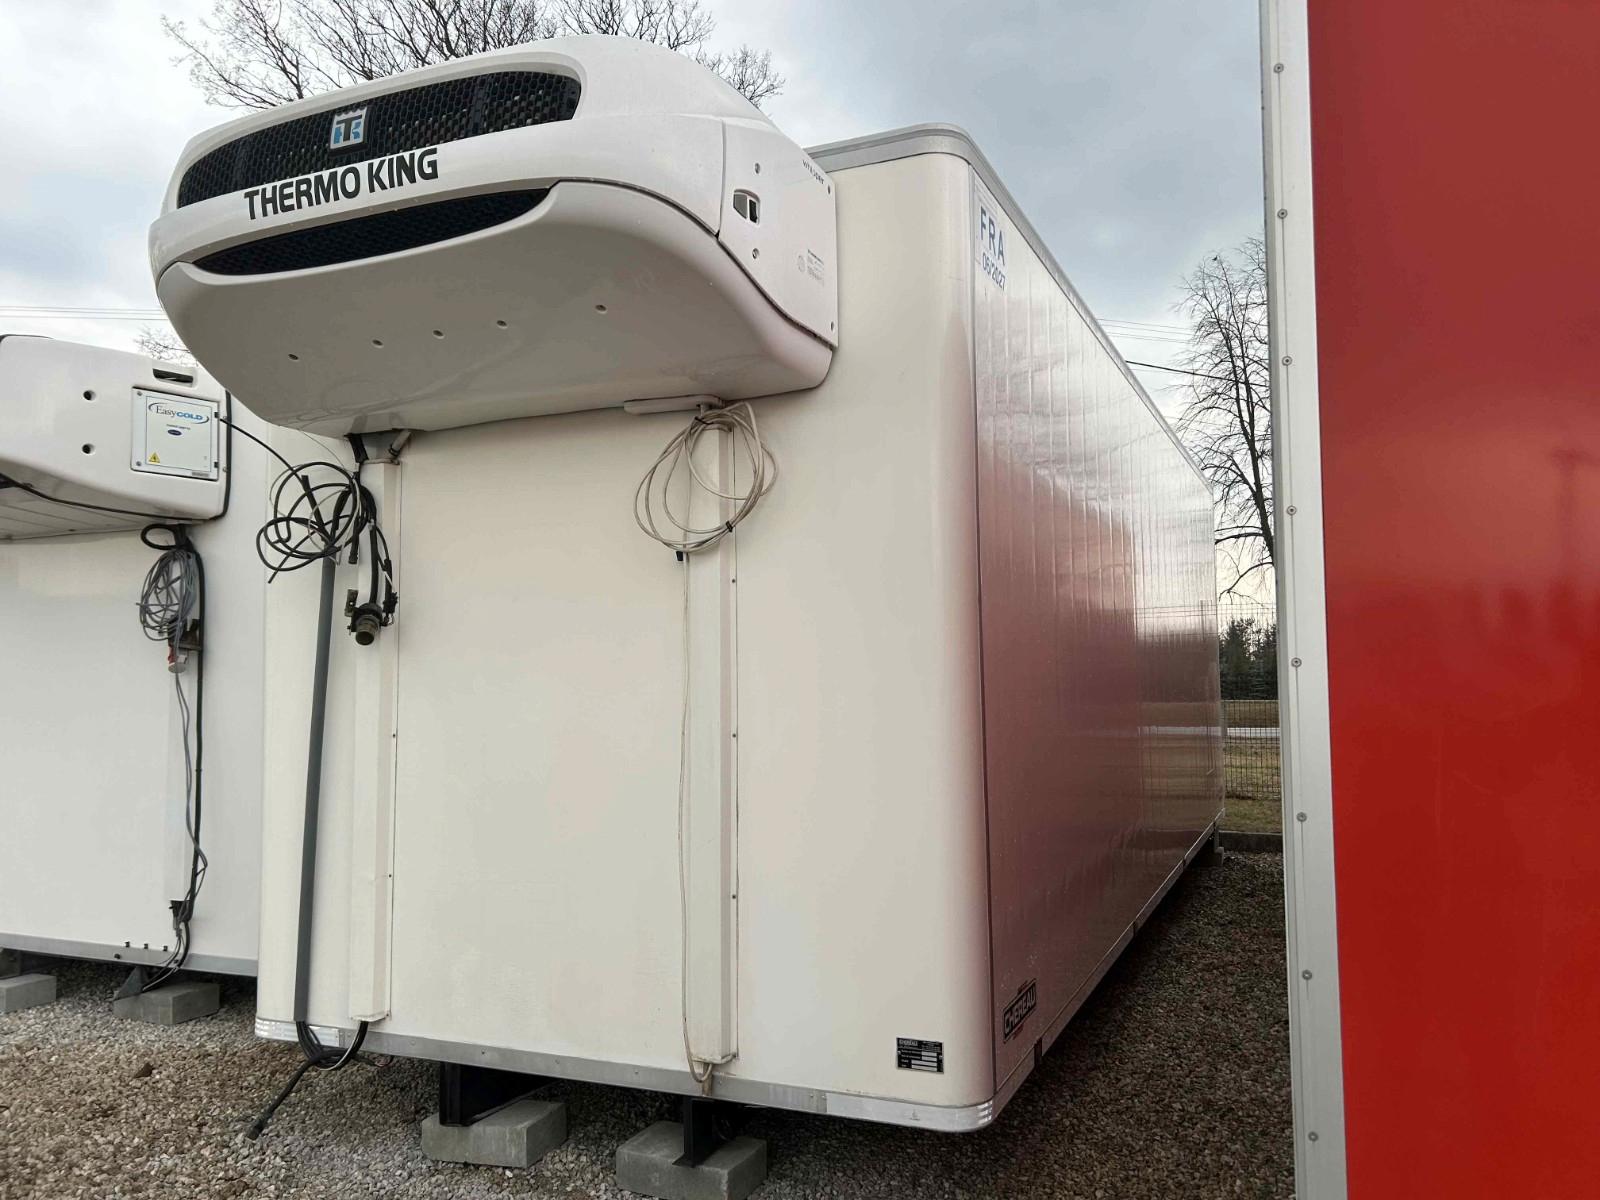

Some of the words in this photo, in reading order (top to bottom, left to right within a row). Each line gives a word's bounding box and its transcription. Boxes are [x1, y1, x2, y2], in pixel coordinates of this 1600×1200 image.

[244, 166, 361, 220] THERMO
[367, 147, 439, 194] KING
[980, 205, 1005, 267] FRA
[1004, 984, 1037, 1036] CHEREAU
